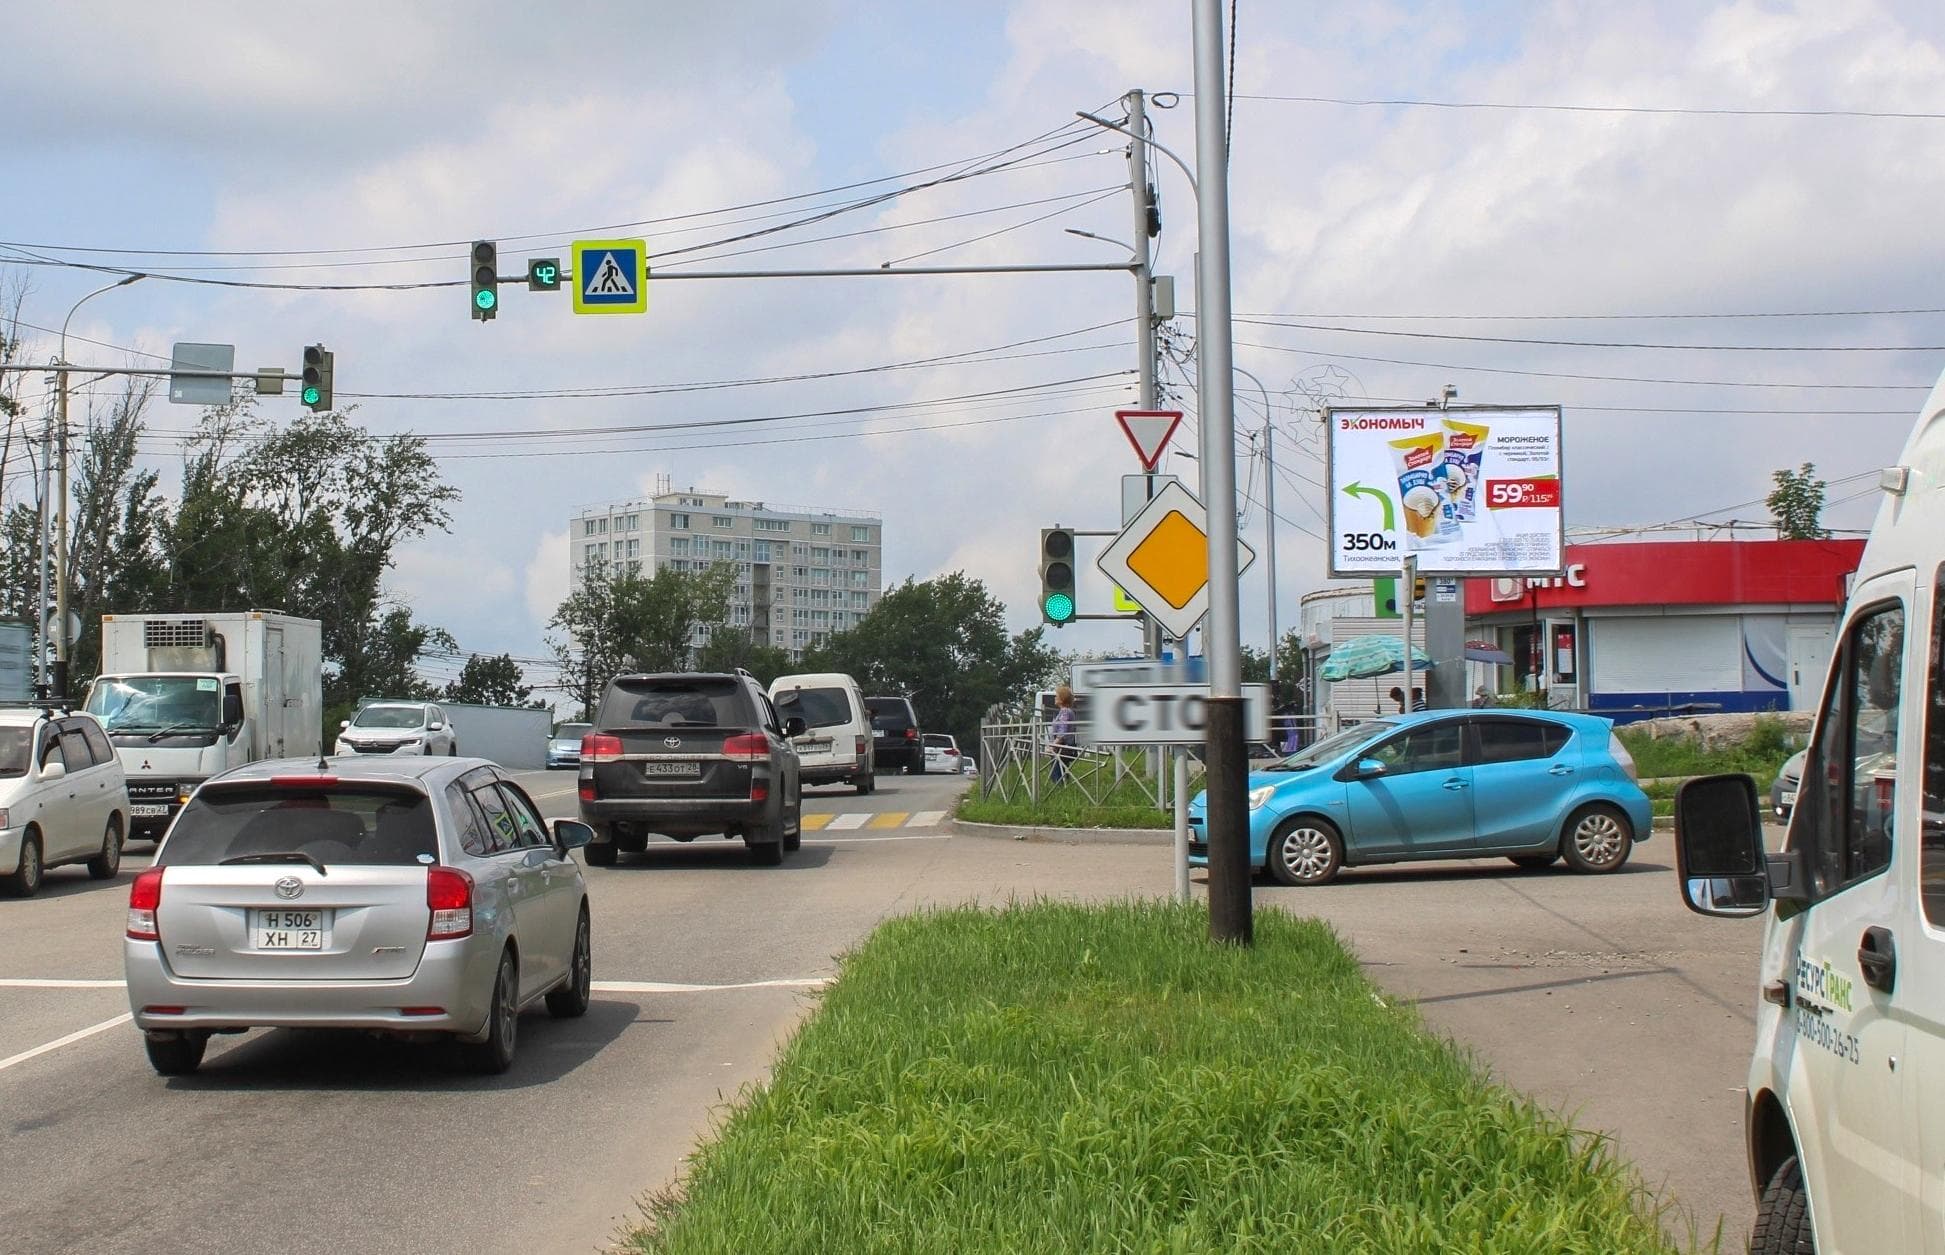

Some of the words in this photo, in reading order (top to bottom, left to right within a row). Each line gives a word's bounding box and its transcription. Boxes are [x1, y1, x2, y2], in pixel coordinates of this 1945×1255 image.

[536, 266, 555, 284] 42
[1341, 417, 1424, 430] ЭКОНОМЫЧ
[1497, 436, 1550, 444] МОРОЖЕНОЕ
[1493, 484, 1523, 503] 59
[1113, 694, 1210, 731] СТО
[285, 913, 313, 927] 506
[265, 931, 288, 946] ХН
[302, 931, 317, 943] 27
